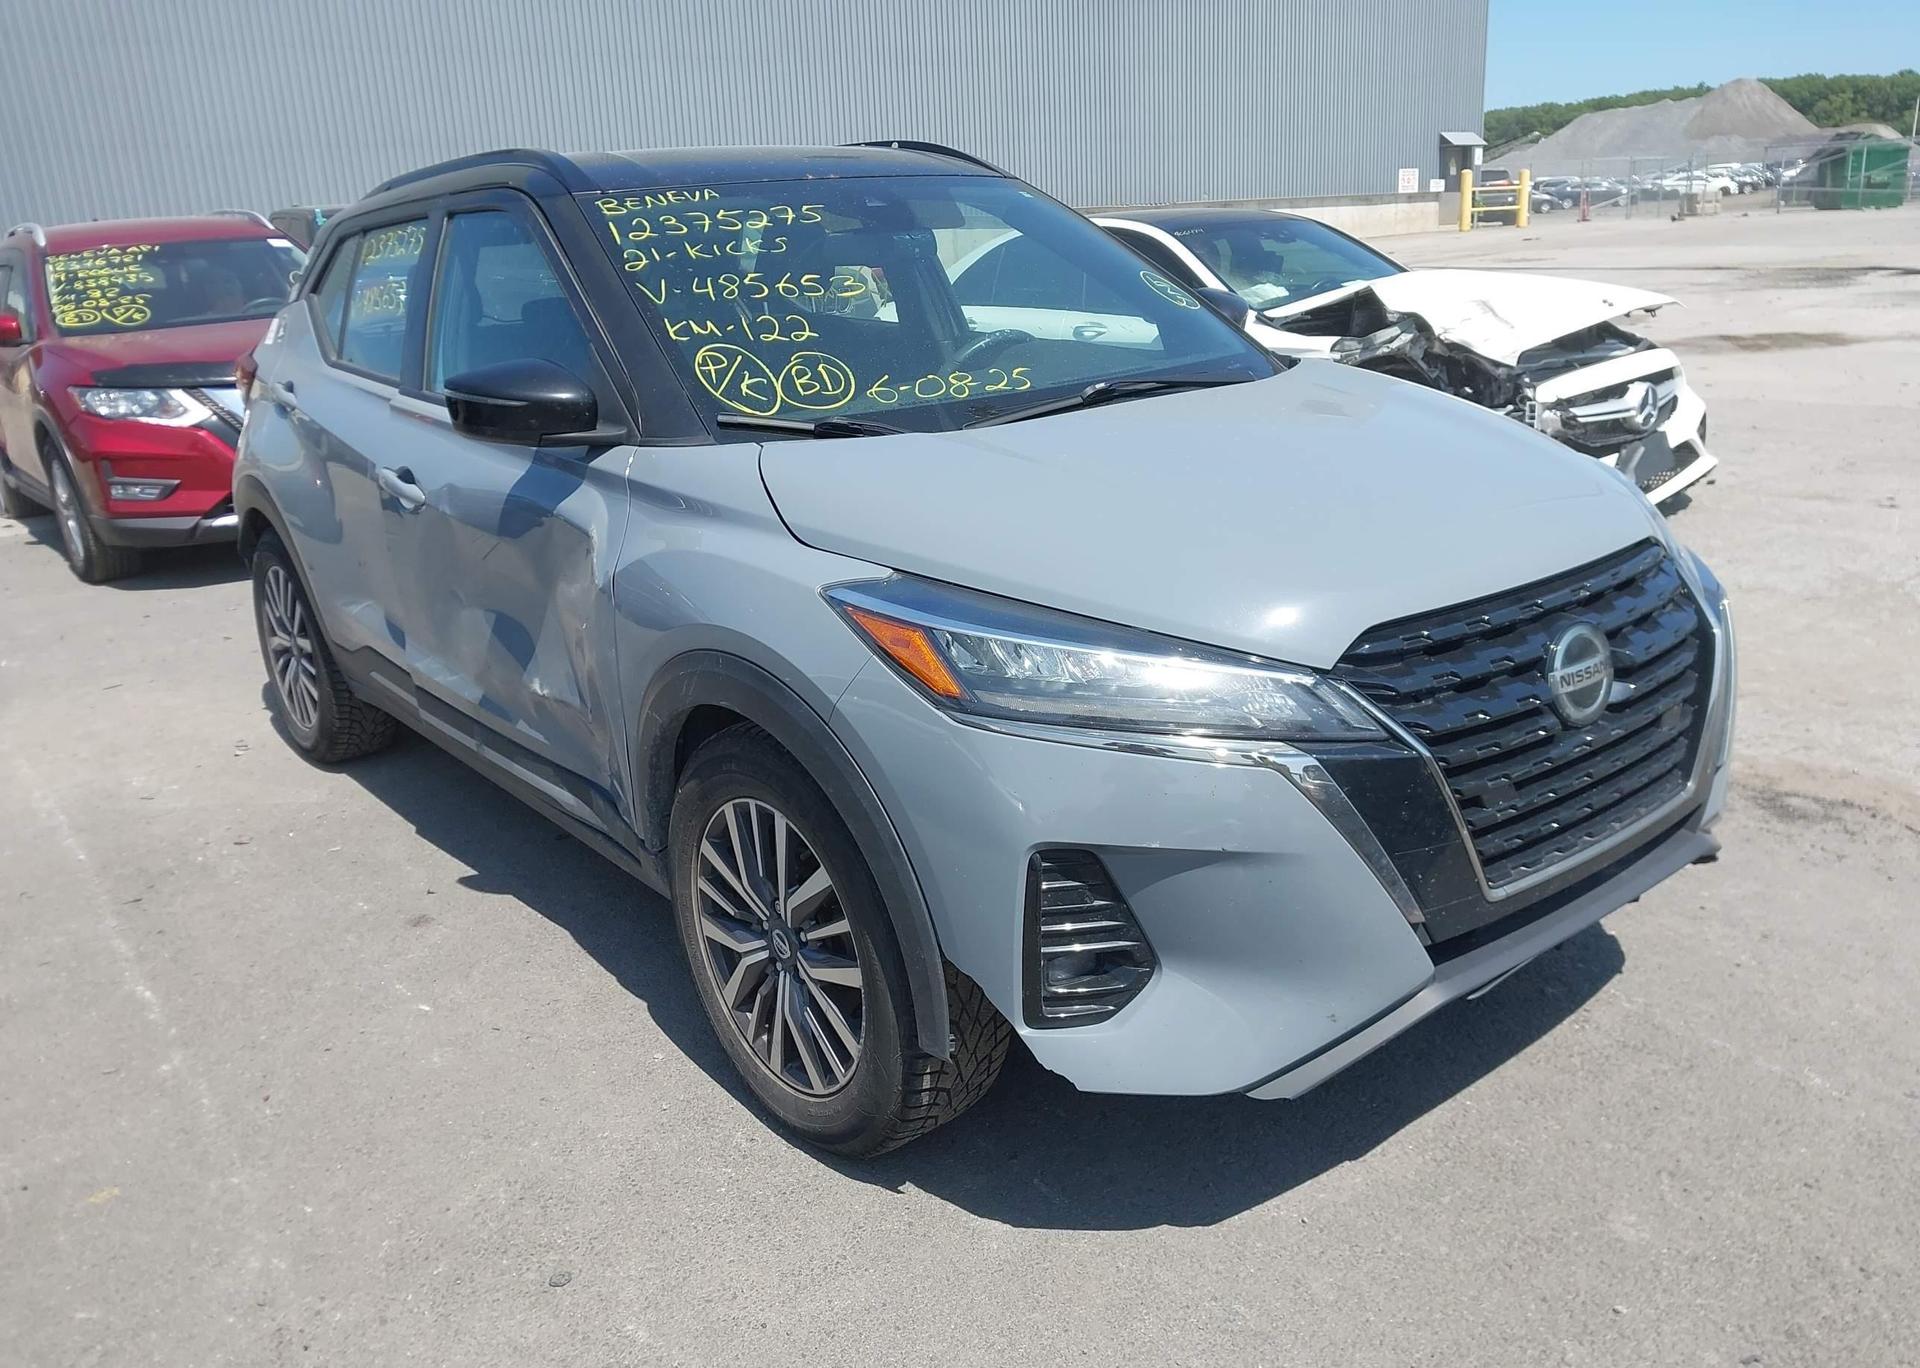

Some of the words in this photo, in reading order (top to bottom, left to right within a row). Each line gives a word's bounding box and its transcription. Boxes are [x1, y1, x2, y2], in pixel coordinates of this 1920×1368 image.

[595, 188, 720, 215] BENEVA
[609, 205, 825, 245] 12375275
[624, 237, 788, 272] 21-KICKS
[635, 273, 868, 304] V-485653
[663, 315, 819, 341] KM-122
[1560, 661, 1610, 688] NISSAN
